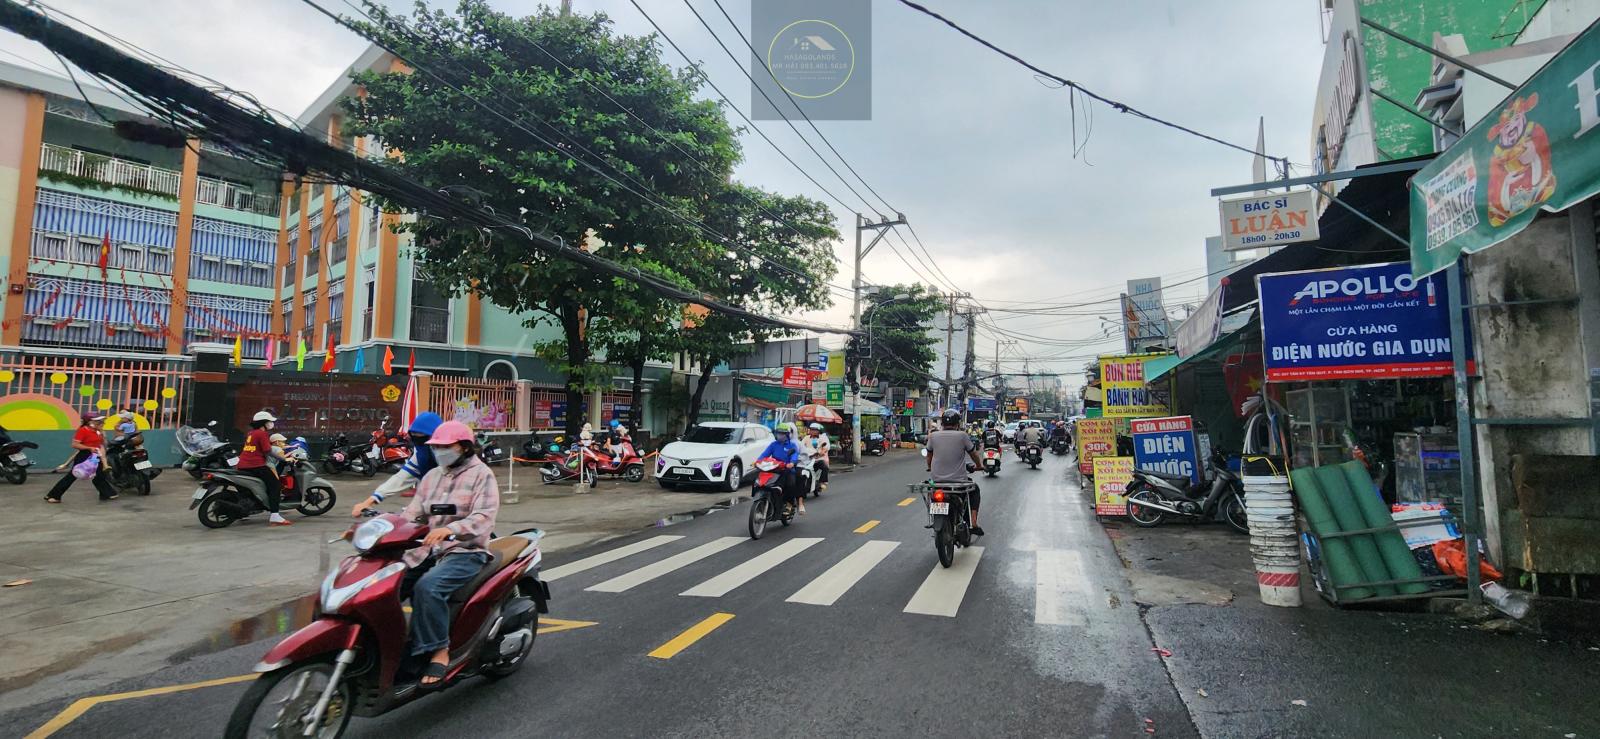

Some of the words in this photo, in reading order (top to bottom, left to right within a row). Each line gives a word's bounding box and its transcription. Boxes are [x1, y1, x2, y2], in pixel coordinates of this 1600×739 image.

[1243, 199, 1270, 213] BÁC
[1241, 234, 1267, 245] 18h00
[1274, 230, 1301, 241] 20h30
[1292, 273, 1419, 300] APOLLO
[1353, 304, 1369, 312] MỘT
[1327, 325, 1357, 337] CỬA
[1359, 323, 1398, 335] HÀNG
[1272, 343, 1313, 363] ĐIỆN
[1318, 339, 1367, 359] NƯỚC
[1373, 340, 1405, 356] GIA
[1410, 337, 1450, 357] DỤN
[1105, 360, 1123, 382] BÚN
[1126, 359, 1143, 381] RIÊ
[1106, 384, 1129, 406] BÁNH
[1136, 421, 1156, 432] CỬA
[1159, 420, 1186, 431] HÀNG
[1087, 443, 1109, 451] 30K
[1143, 434, 1186, 457] ĐIỆN
[1103, 483, 1127, 491] 30K
